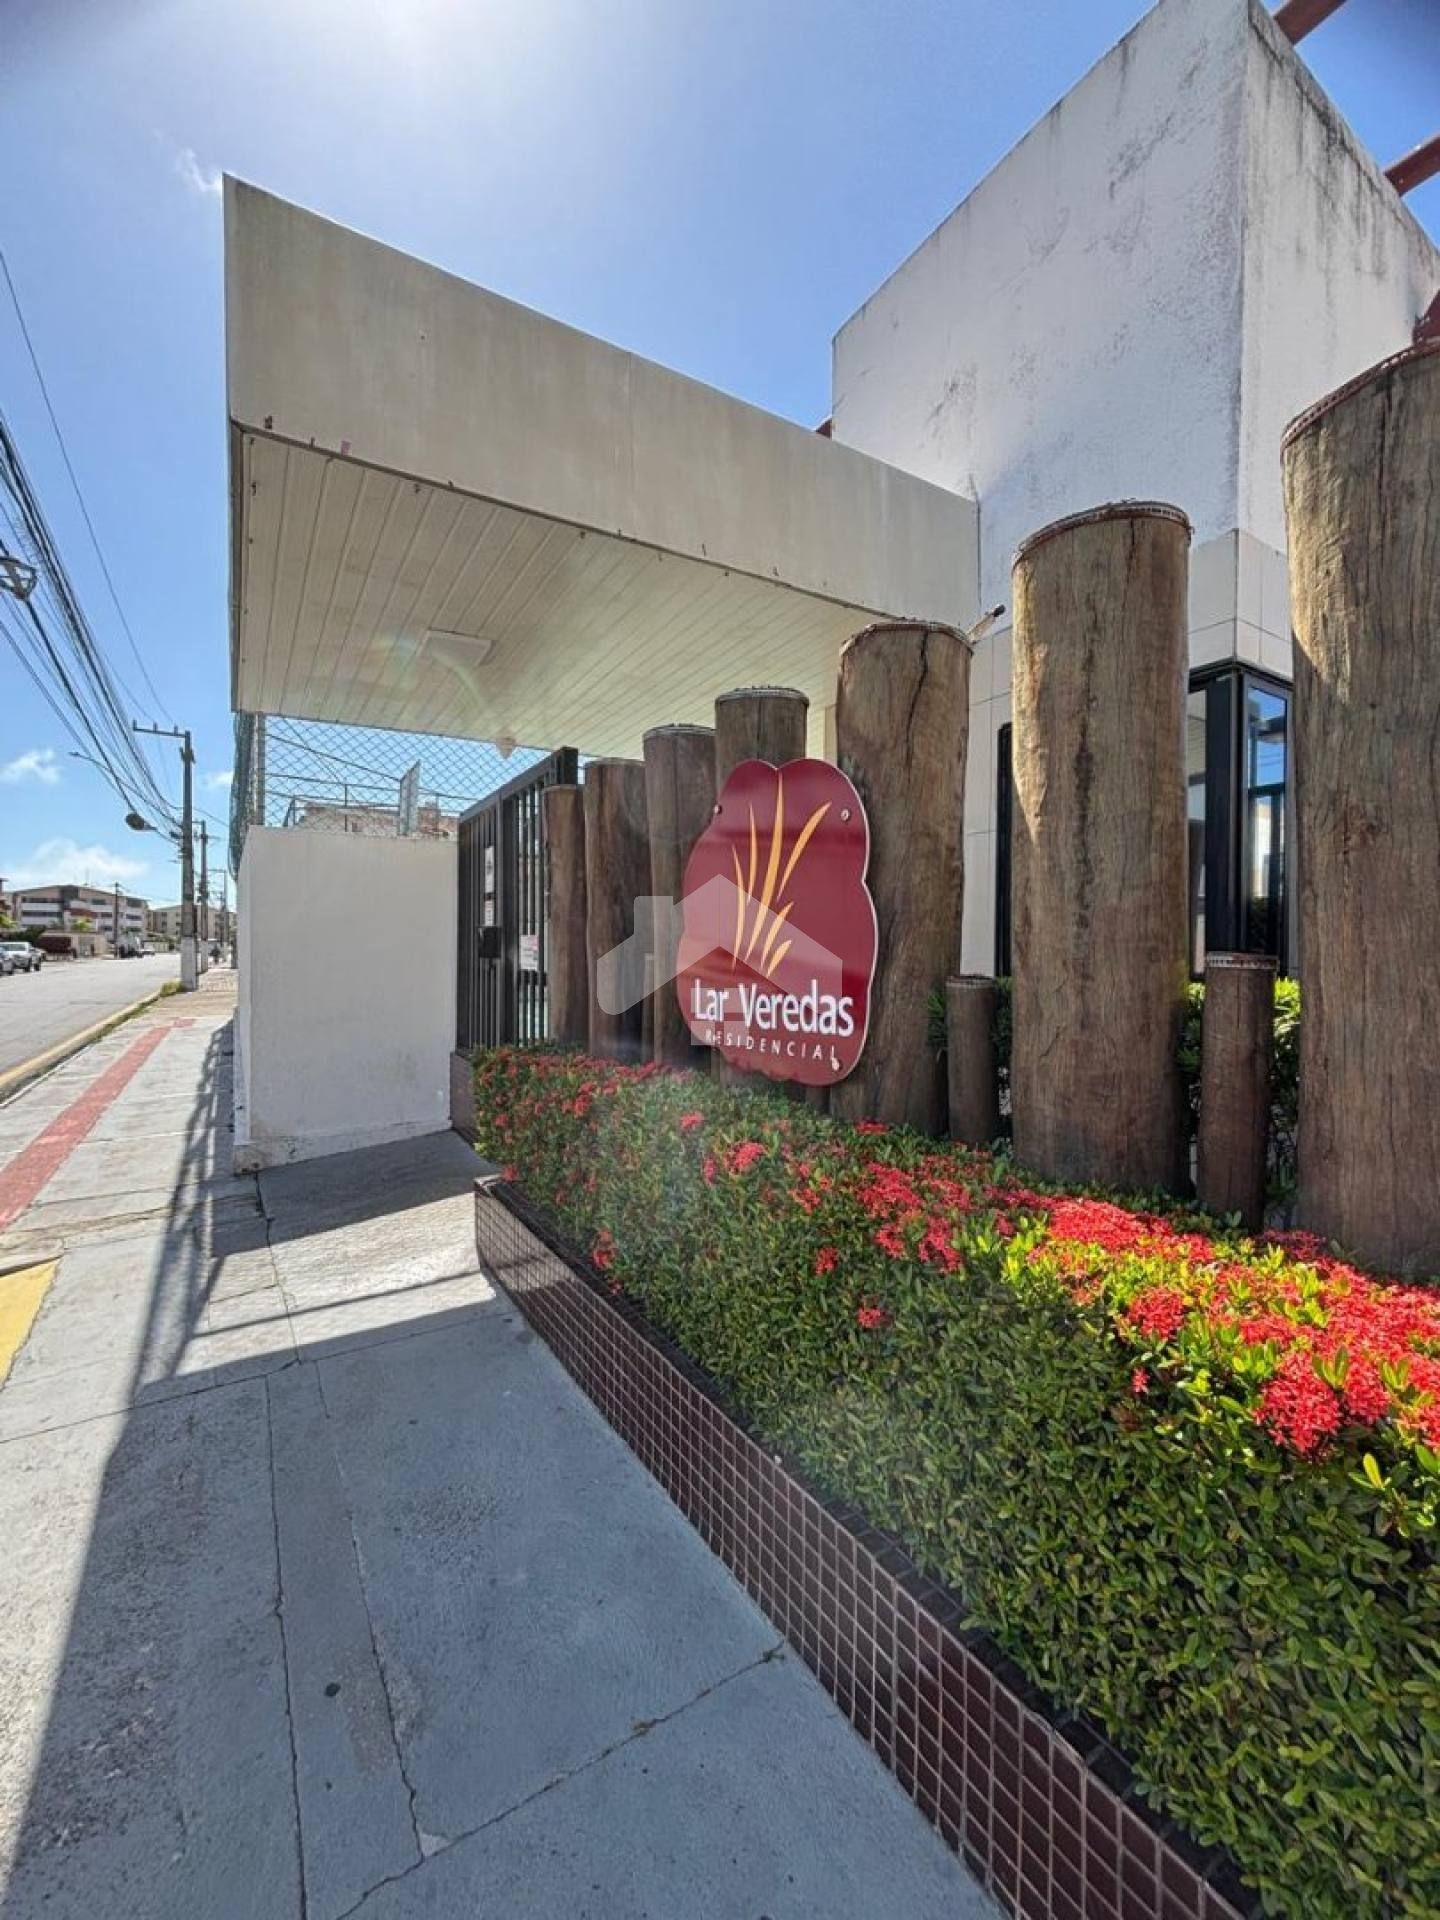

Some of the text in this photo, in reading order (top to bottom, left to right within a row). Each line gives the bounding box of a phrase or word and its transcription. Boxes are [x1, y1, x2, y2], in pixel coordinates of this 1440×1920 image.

[694, 978, 854, 1037] Lar Veredas
[705, 1029, 837, 1061] RESIDENCIAL
